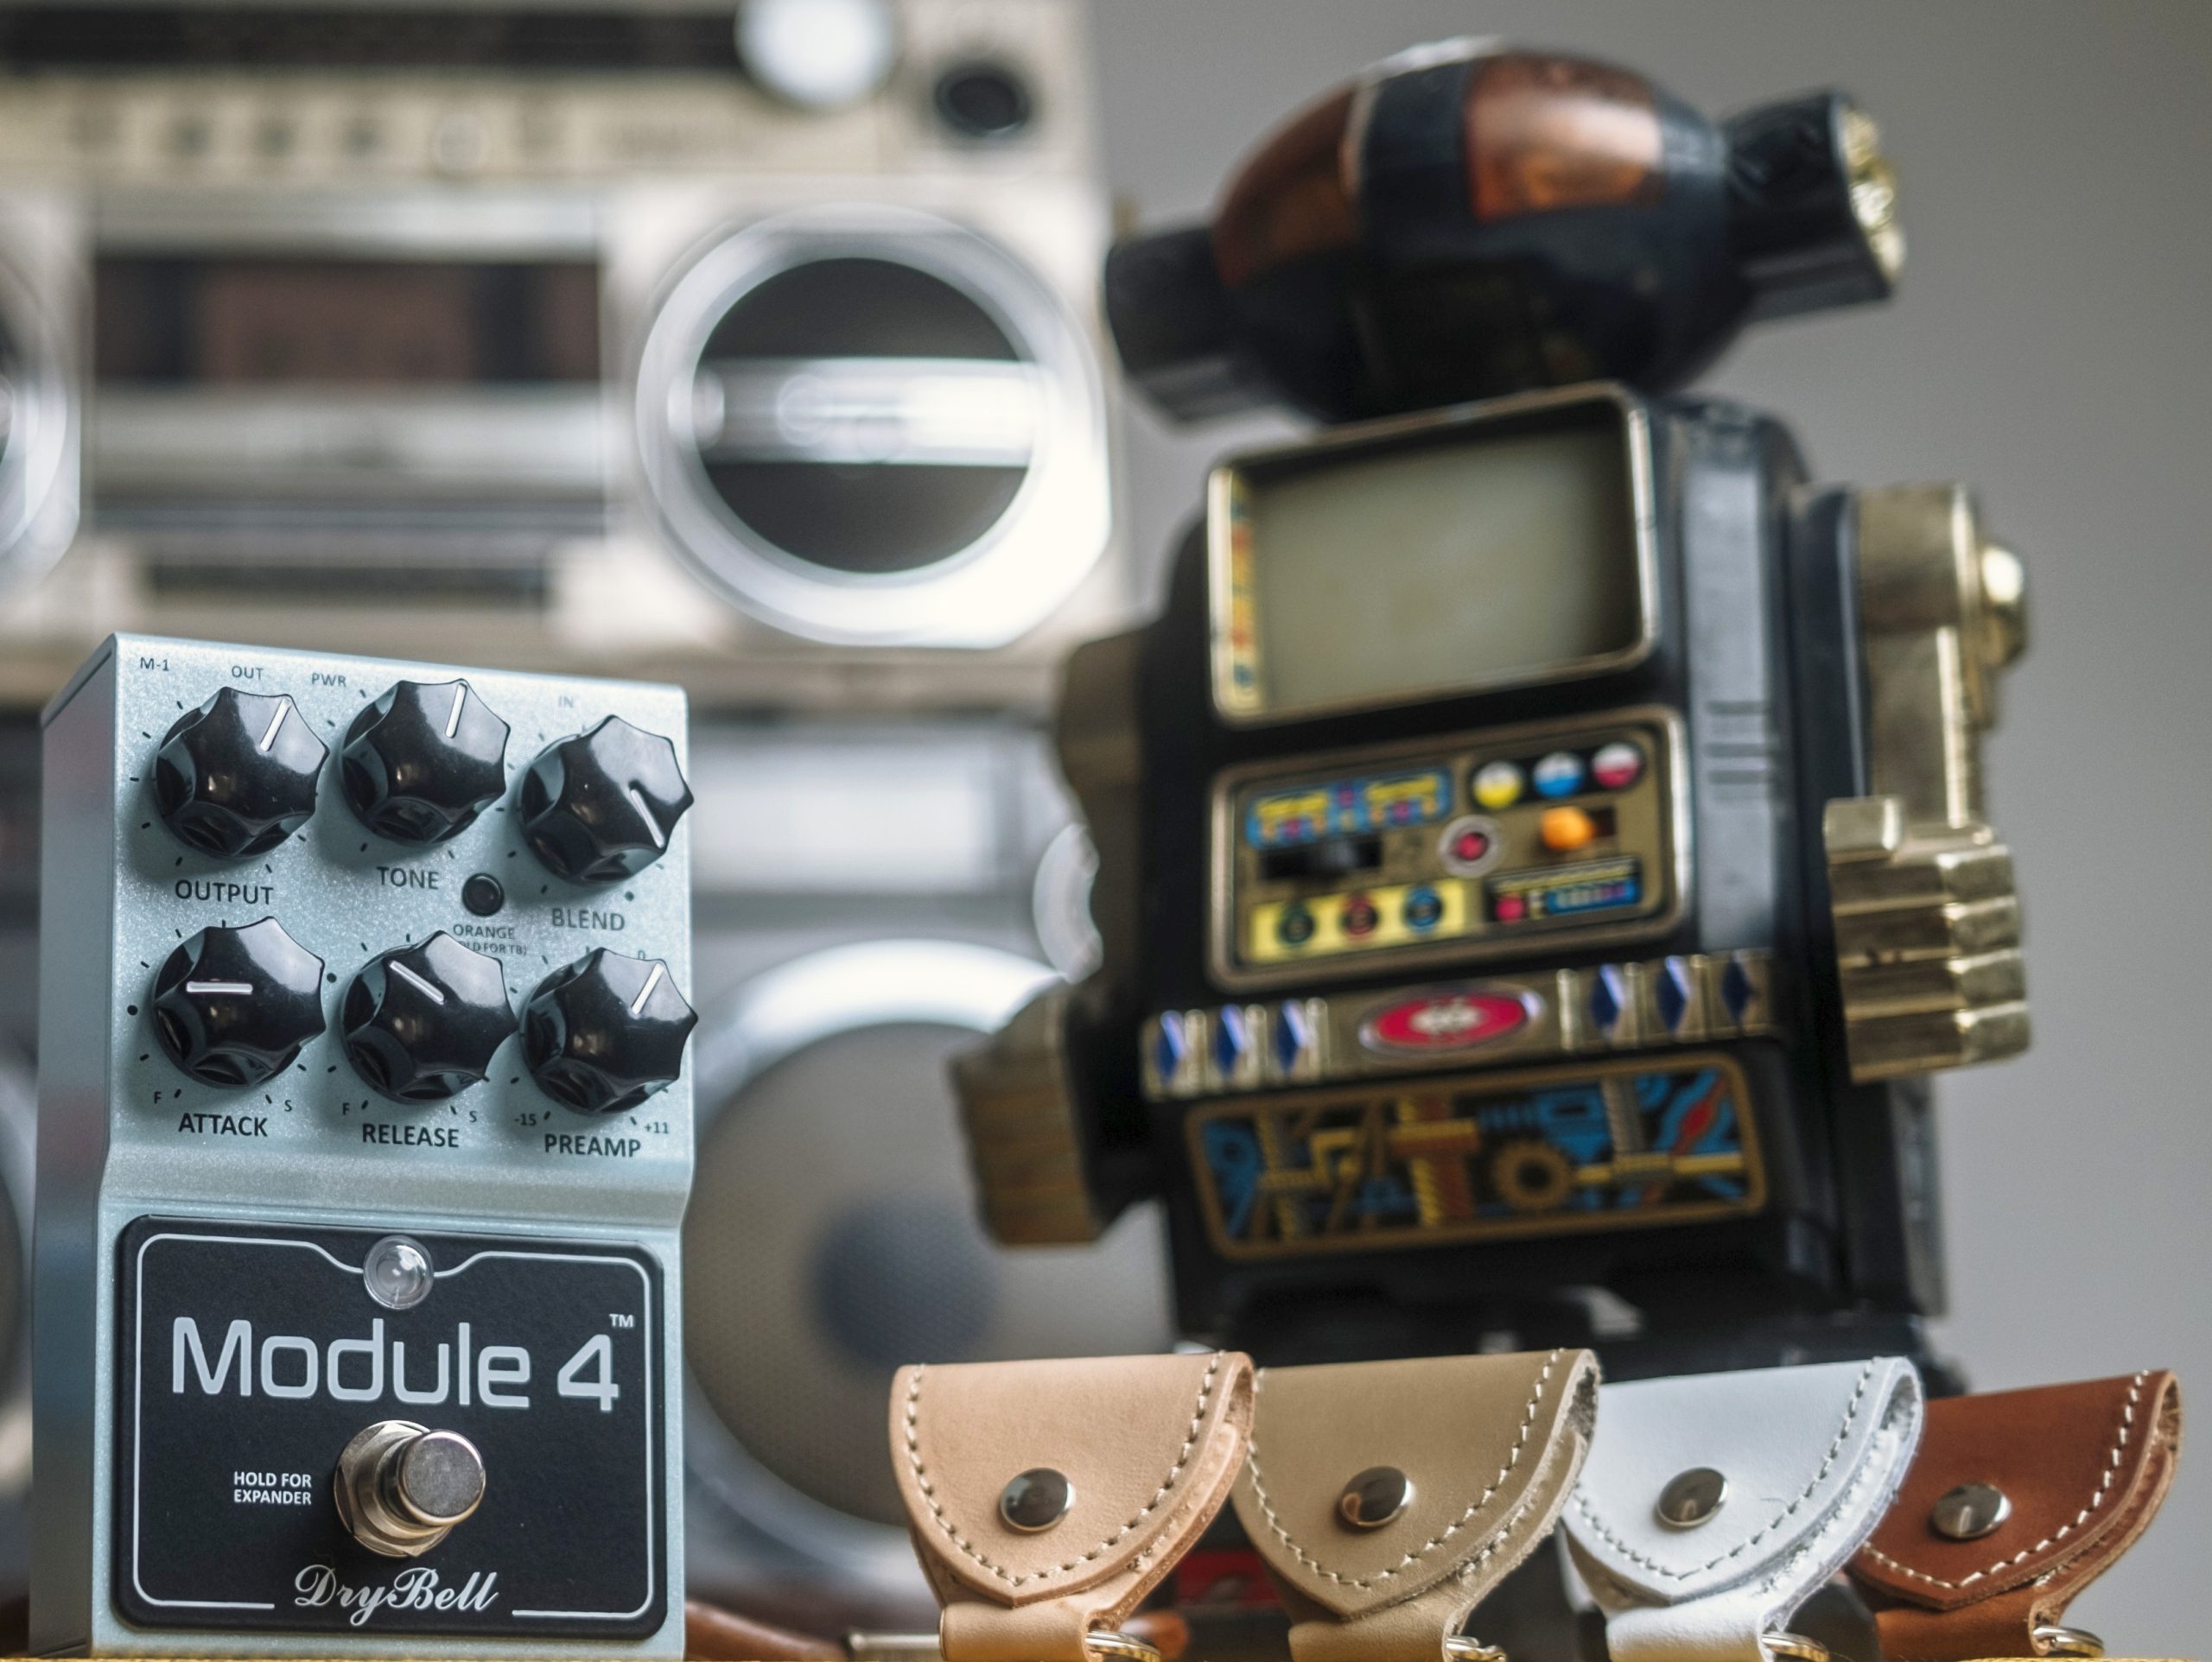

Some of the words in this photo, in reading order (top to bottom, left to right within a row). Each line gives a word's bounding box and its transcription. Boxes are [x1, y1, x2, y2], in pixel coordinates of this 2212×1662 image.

[139, 657, 170, 671] M-1
[231, 665, 264, 680] OUT
[311, 673, 346, 688] PWR
[557, 695, 574, 708] IN
[377, 866, 439, 889] TONE
[175, 879, 275, 905] OUTPUT
[550, 908, 625, 931] BLEND
[453, 923, 515, 940] ORANGE
[483, 942, 506, 954] FOR
[509, 944, 527, 956] TB)
[154, 1091, 162, 1105] F
[284, 1099, 293, 1113] S
[342, 1102, 350, 1115] F
[468, 1110, 478, 1123] S
[178, 1112, 269, 1138] ATTACK
[514, 1113, 537, 1126] -15
[645, 1121, 670, 1134] +11
[362, 1123, 459, 1148] RELEASE
[544, 1133, 641, 1158] PREAMP
[173, 1317, 531, 1408] Module
[557, 1334, 620, 1412] 4
[233, 1471, 277, 1487] HOLD
[281, 1473, 312, 1488] FOR
[233, 1488, 312, 1506] EXPANDER
[294, 1564, 499, 1627] DryBell
